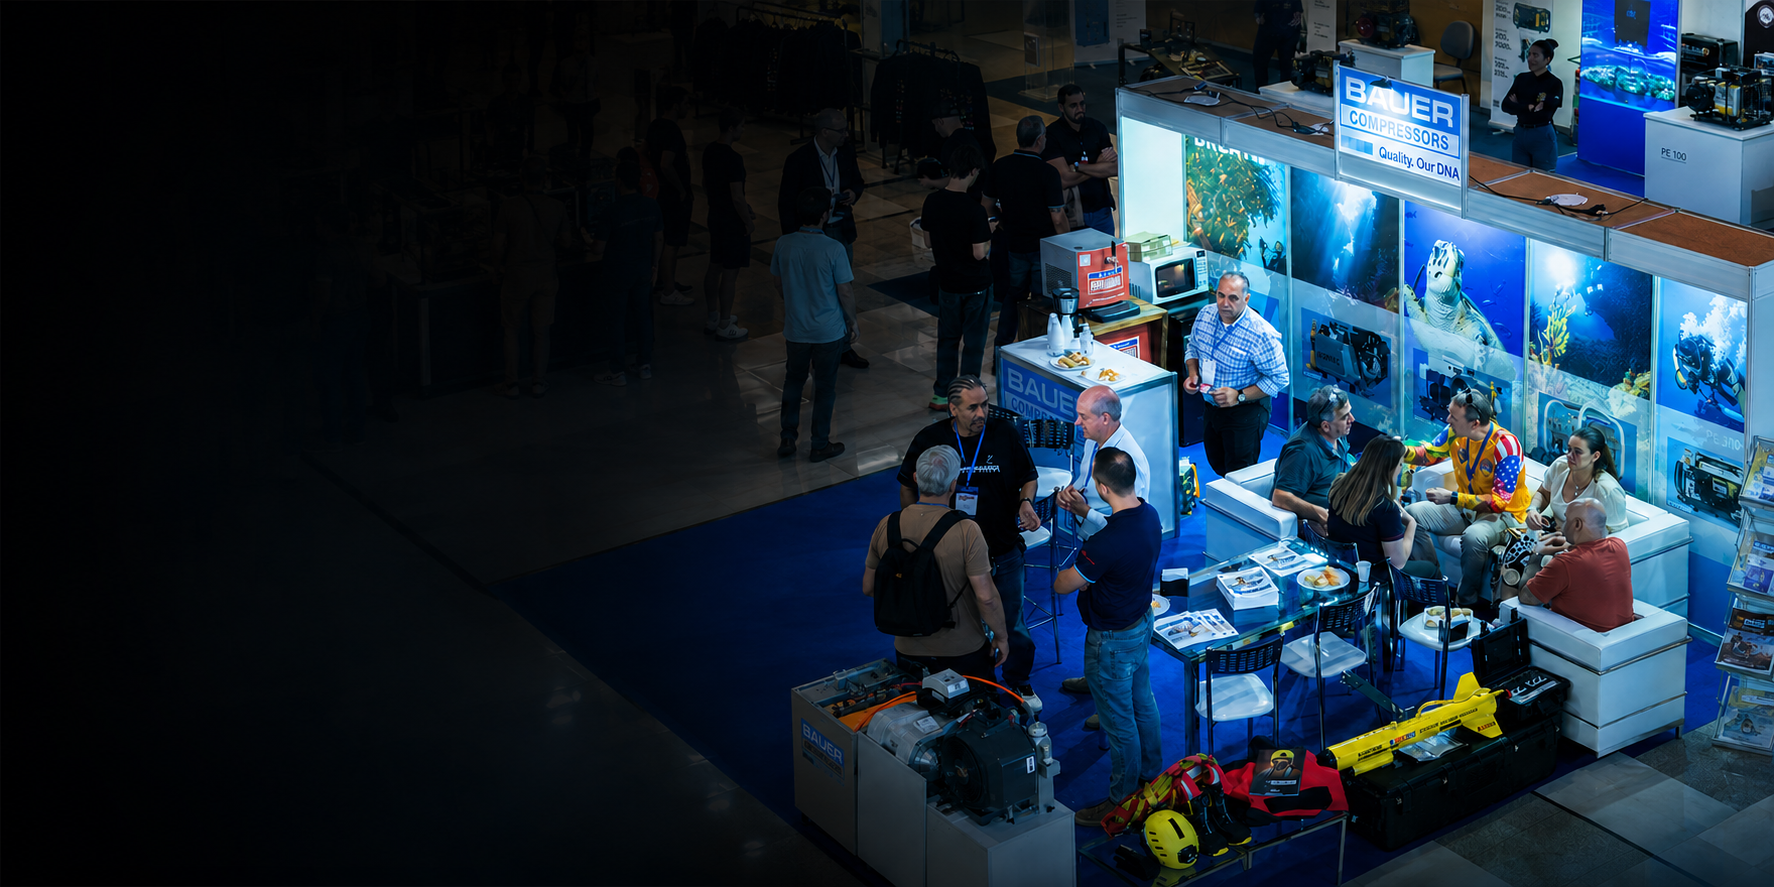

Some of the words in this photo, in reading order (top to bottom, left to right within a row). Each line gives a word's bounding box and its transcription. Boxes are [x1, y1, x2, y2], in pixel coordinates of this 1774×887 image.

[1346, 76, 1453, 128] BAUER
[1350, 110, 1449, 151] COMPRESSORS
[1379, 147, 1414, 169] Quality.
[1416, 157, 1436, 173] Our
[1437, 163, 1460, 181] DNA
[1661, 147, 1671, 157] PE
[1673, 150, 1686, 161] 100
[1007, 367, 1077, 418] BAUE
[803, 723, 843, 765] BAUER
